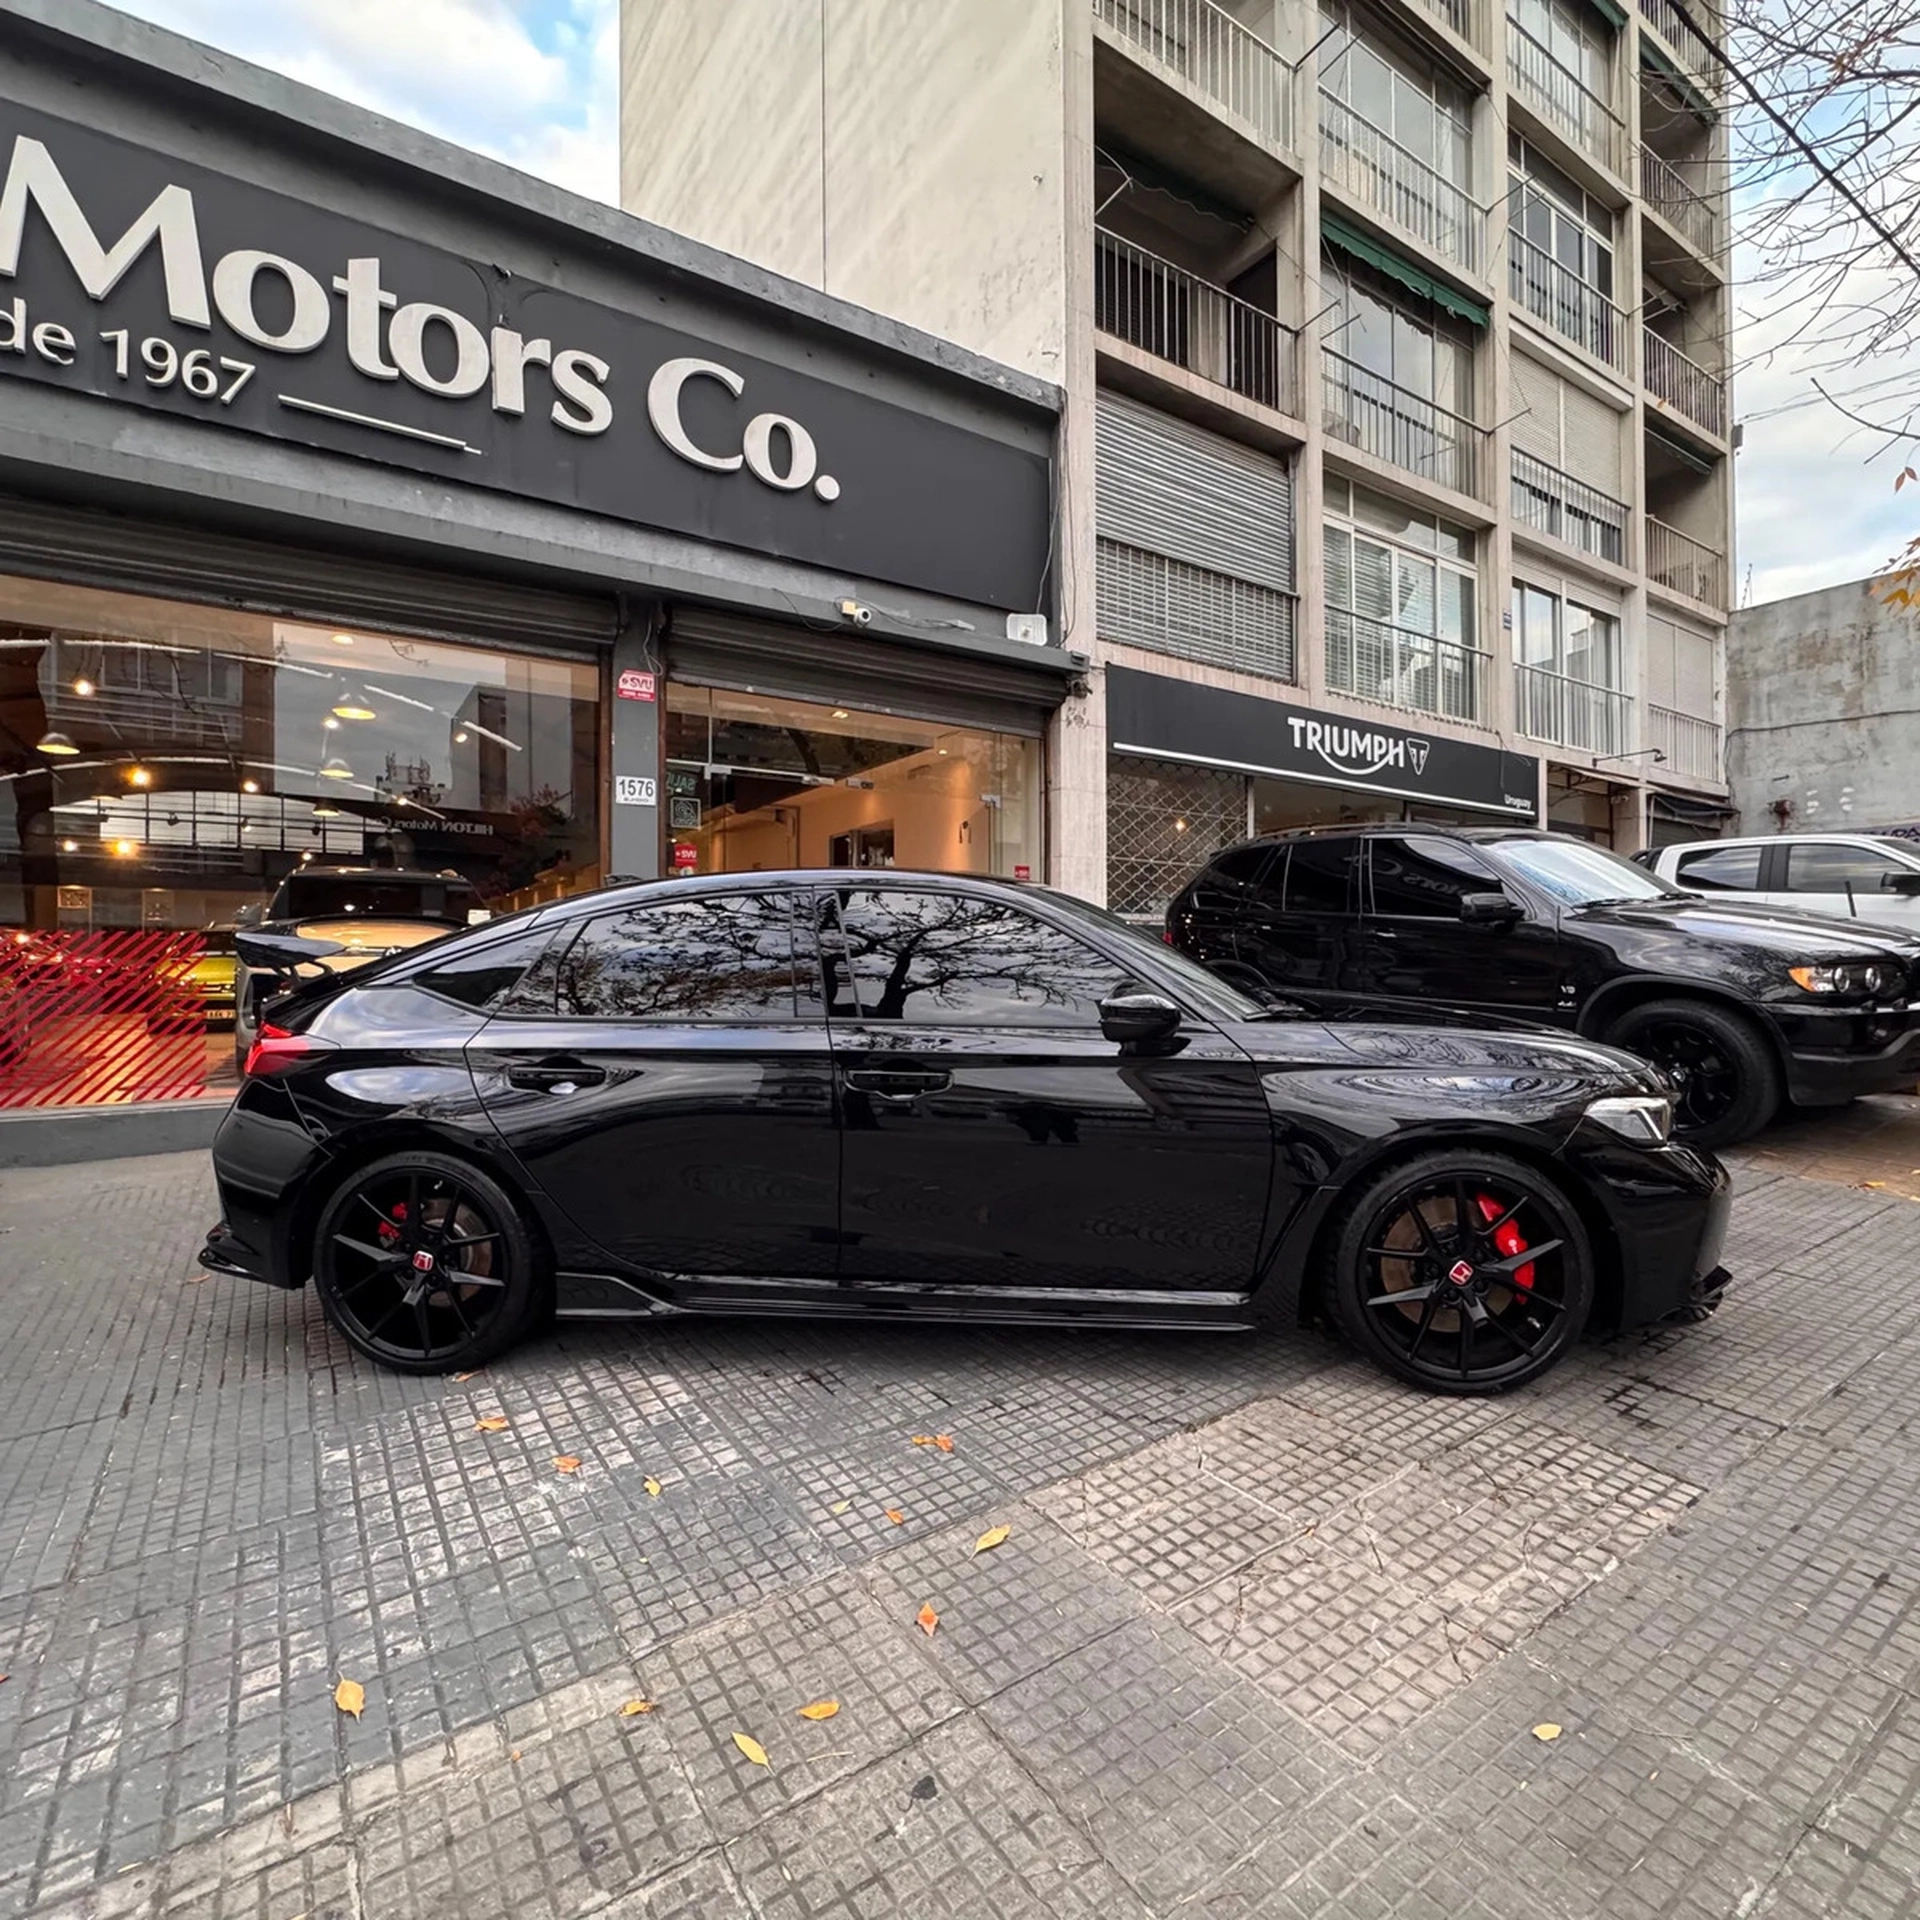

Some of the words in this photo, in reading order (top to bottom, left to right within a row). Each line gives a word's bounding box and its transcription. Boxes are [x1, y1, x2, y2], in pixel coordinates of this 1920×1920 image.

[0, 134, 613, 436] Motors
[648, 357, 841, 501] Co.
[100, 328, 256, 404] 1967
[630, 677, 653, 690] SVU
[1287, 716, 1405, 775] TRIUMPH
[618, 779, 654, 797] 1576
[1504, 793, 1532, 810] Uruguay
